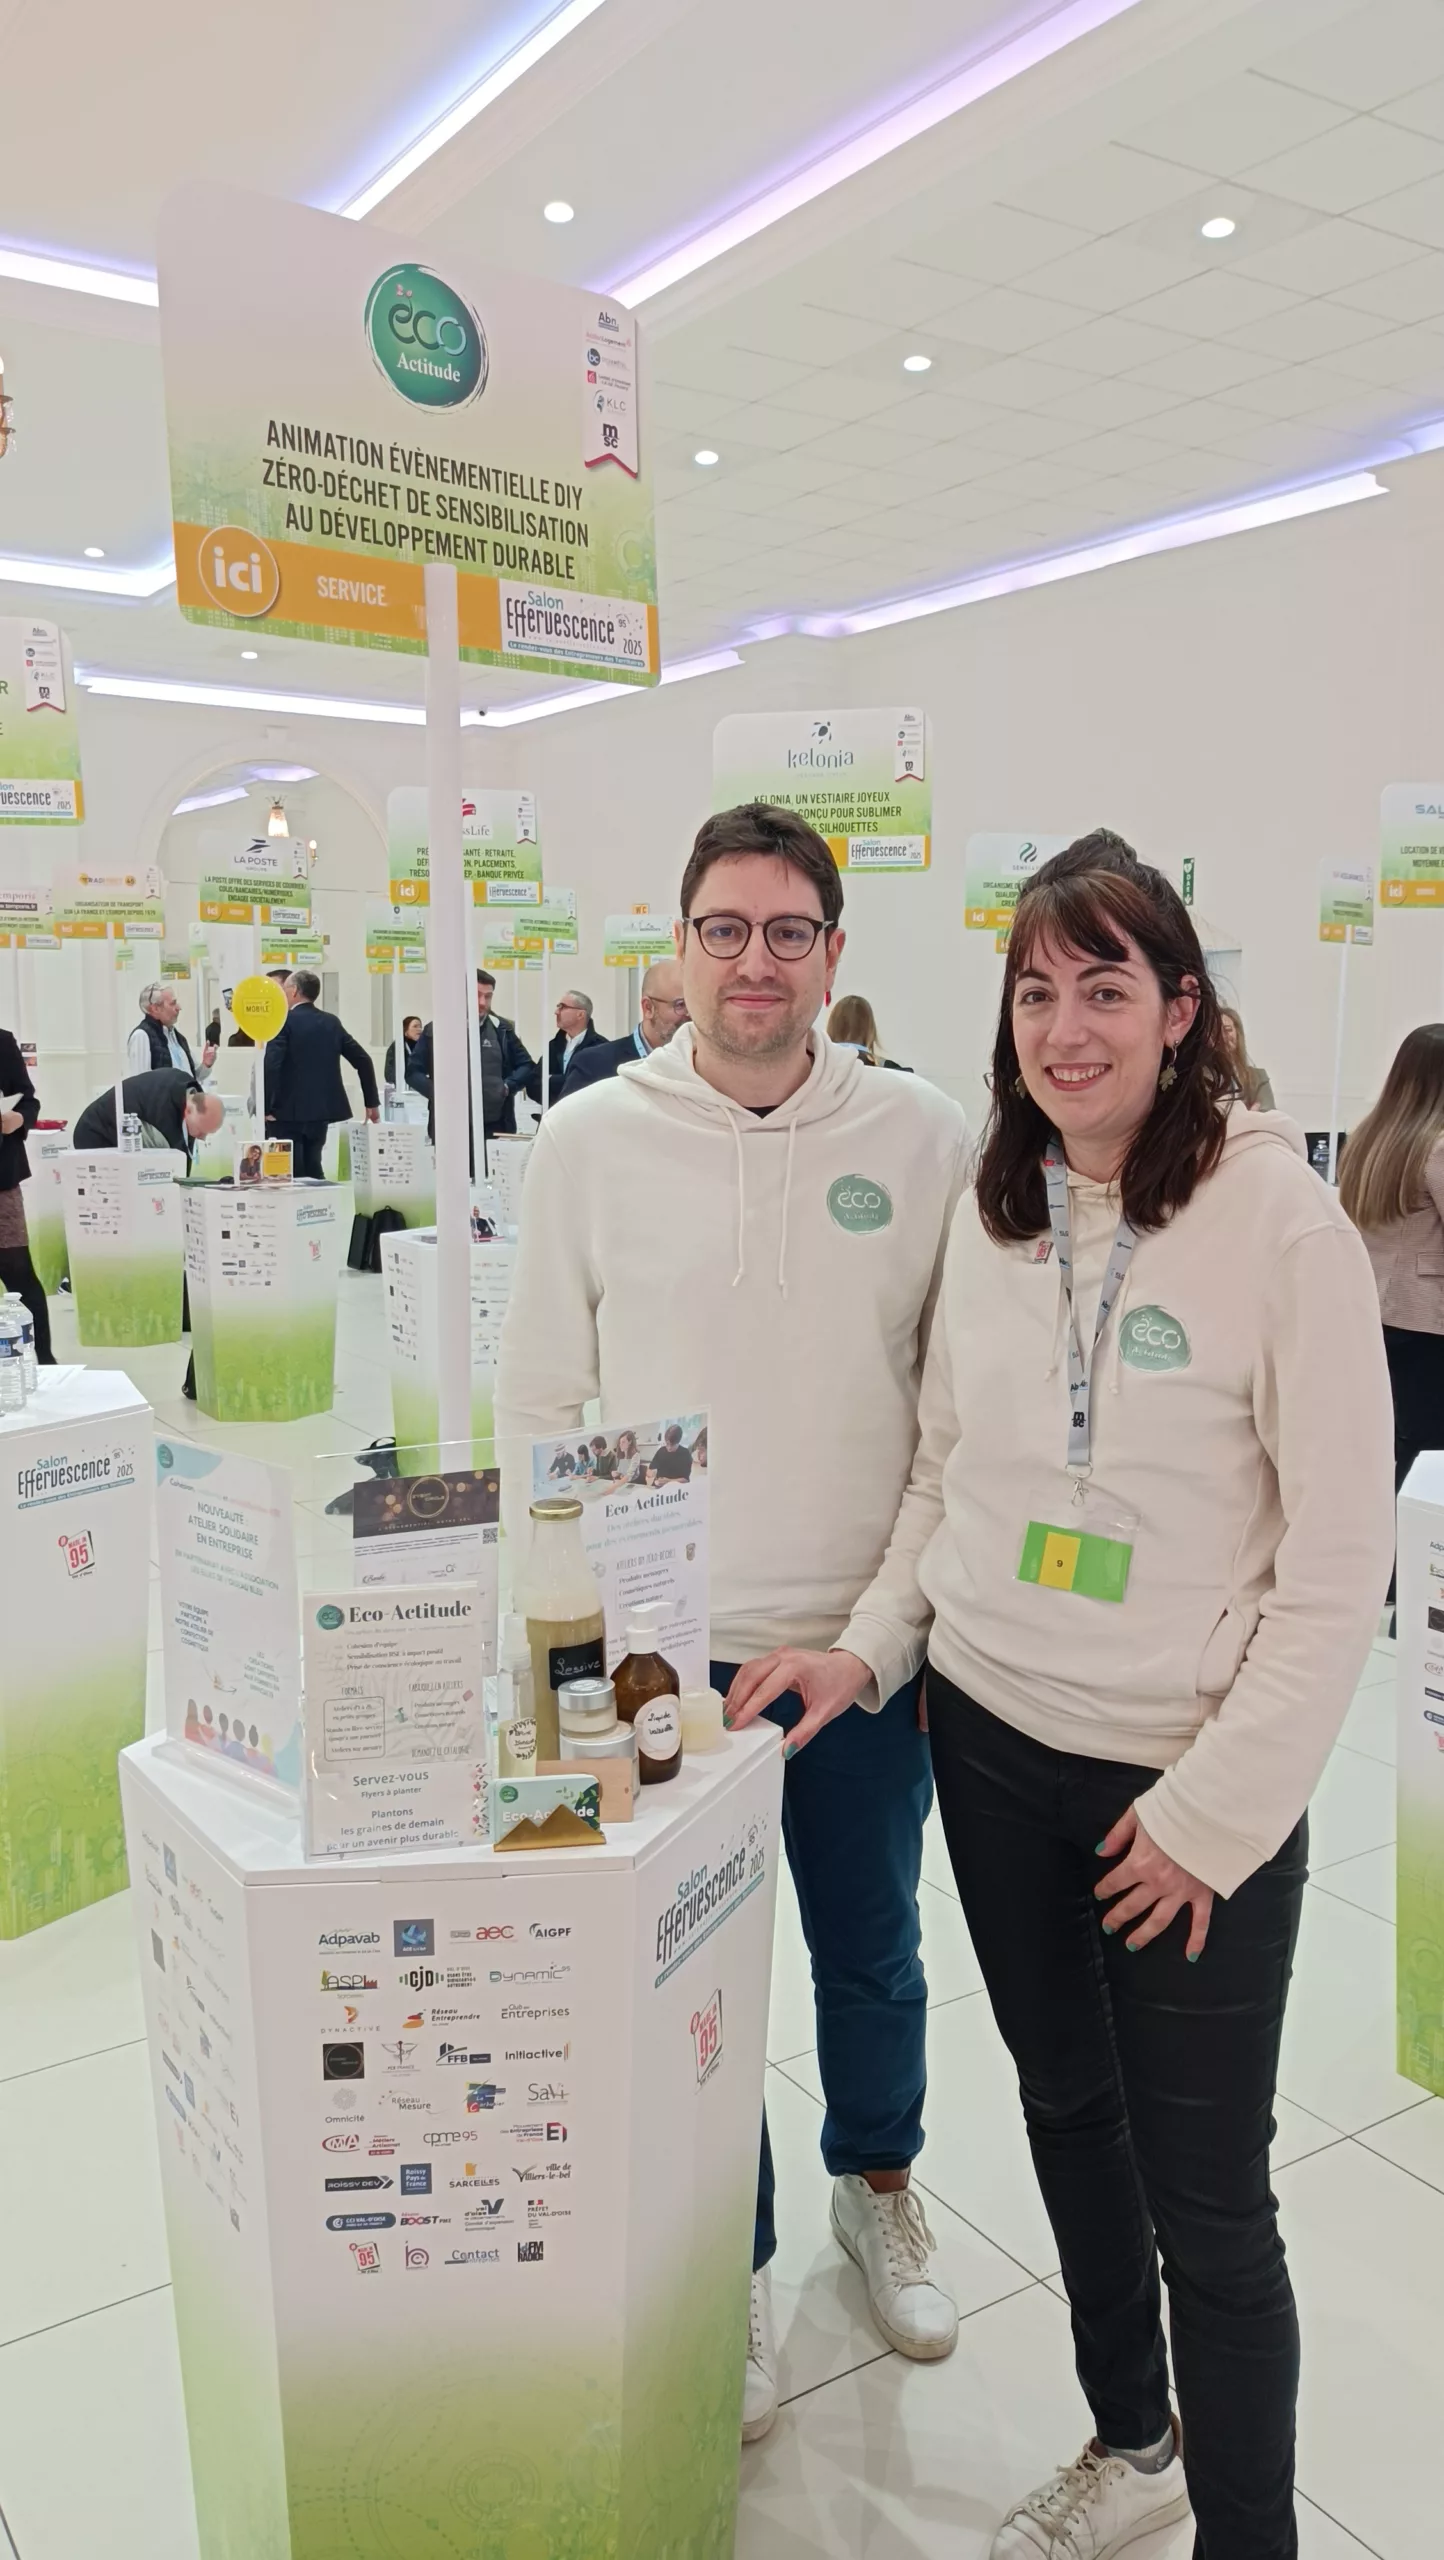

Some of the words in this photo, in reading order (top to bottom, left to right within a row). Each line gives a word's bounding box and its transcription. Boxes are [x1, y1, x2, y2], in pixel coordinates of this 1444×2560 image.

[397, 352, 461, 383] Actitude
[266, 420, 384, 470] ANIMATION
[390, 441, 550, 505] ÉVÈNEMENTIELLE
[554, 482, 583, 511] DIY
[262, 456, 401, 511] ZÉRO-DÉCHET
[406, 487, 431, 517] DE
[435, 494, 589, 548] SENSIBILISATION
[286, 502, 313, 533] AU
[319, 507, 488, 564] DÉVELOPPEMENT
[493, 541, 576, 580] DURABLE
[213, 546, 263, 594] ici
[317, 575, 388, 606] SERVICE
[528, 590, 564, 610] Salon
[623, 638, 643, 656] 2025
[788, 747, 854, 769] kelonia
[796, 792, 808, 804] UN
[810, 791, 855, 804] VESTIAIRE
[857, 791, 890, 803] JOYEUX
[830, 807, 855, 819] POUR
[856, 806, 902, 818] SUBLIMER
[818, 821, 879, 833] SILHOUETTES
[234, 856, 246, 864] LA
[247, 857, 278, 867] POSTE
[503, 870, 524, 879] PRIVÉE
[36, 1455, 68, 1471] Salon
[116, 1463, 134, 1478] 2025
[197, 1501, 245, 1526] NOUVEAUTÉ
[188, 1515, 217, 1531] ATELIER
[219, 1524, 259, 1546] SOLIDAIRE
[196, 1533, 207, 1544] EN
[208, 1536, 253, 1560] ENTREPRISE
[69, 1543, 89, 1568] 95
[349, 1600, 472, 1624] Eco-Actitude
[352, 1770, 430, 1787] Servez-vous
[361, 1790, 385, 1799] Flyers
[393, 1787, 422, 1796] planter
[371, 1808, 414, 1819] Plantons
[341, 1827, 354, 1836] les
[356, 1823, 393, 1836] graines
[394, 1821, 407, 1830] de
[408, 1818, 445, 1829] demain
[352, 1840, 365, 1848] un
[367, 1836, 398, 1847] avenir
[400, 1834, 420, 1845] plus
[676, 1864, 708, 1905] Salon
[319, 1932, 380, 1947] Adpavab
[476, 1925, 514, 1940] aec
[535, 1927, 571, 1938] AIGPF
[431, 2014, 480, 2022] Entreprendre
[501, 2008, 570, 2020] Entreprises
[320, 2026, 380, 2034] DYNACTIVE
[700, 2016, 717, 2067] 95
[448, 2055, 468, 2063] FFB
[505, 2049, 563, 2060] Initiactive
[399, 2102, 432, 2110] Mesure
[325, 2114, 365, 2124] Omnicité
[546, 2163, 561, 2171] ville
[562, 2162, 571, 2171] de
[327, 2180, 361, 2189] ROISSY
[449, 2178, 500, 2189] SARCELLES
[400, 2216, 440, 2226] BOOST
[358, 2251, 375, 2267] 95
[452, 2249, 500, 2260] Contact
